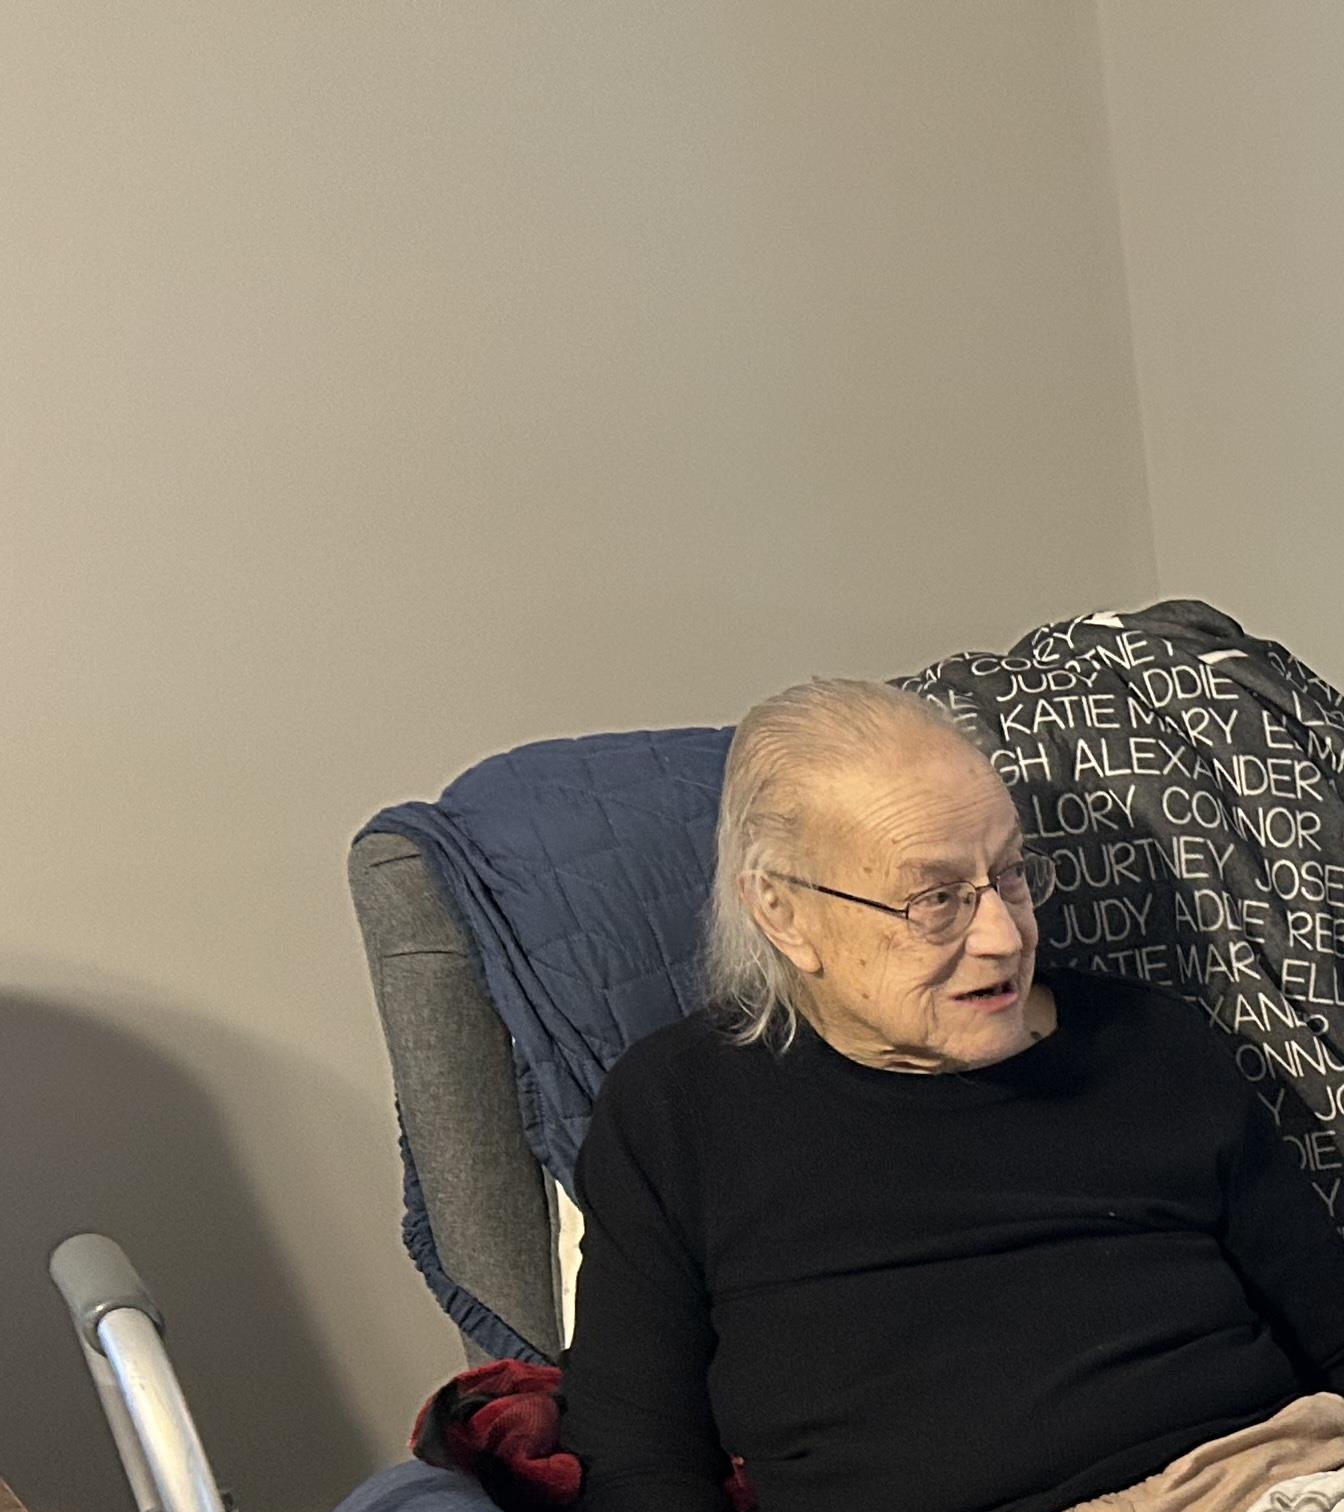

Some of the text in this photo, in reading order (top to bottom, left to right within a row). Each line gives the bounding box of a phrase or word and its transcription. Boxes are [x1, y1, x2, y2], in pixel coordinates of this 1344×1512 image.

[997, 671, 1098, 701] JUDY
[999, 695, 1120, 741] KATIE
[991, 737, 1323, 802] GH ALEXANDER
[1023, 785, 1322, 851] LORY CONNOR
[1052, 836, 1235, 892] OURTNEY
[1050, 893, 1152, 949] JUDY
[1176, 941, 1262, 984] MAR
